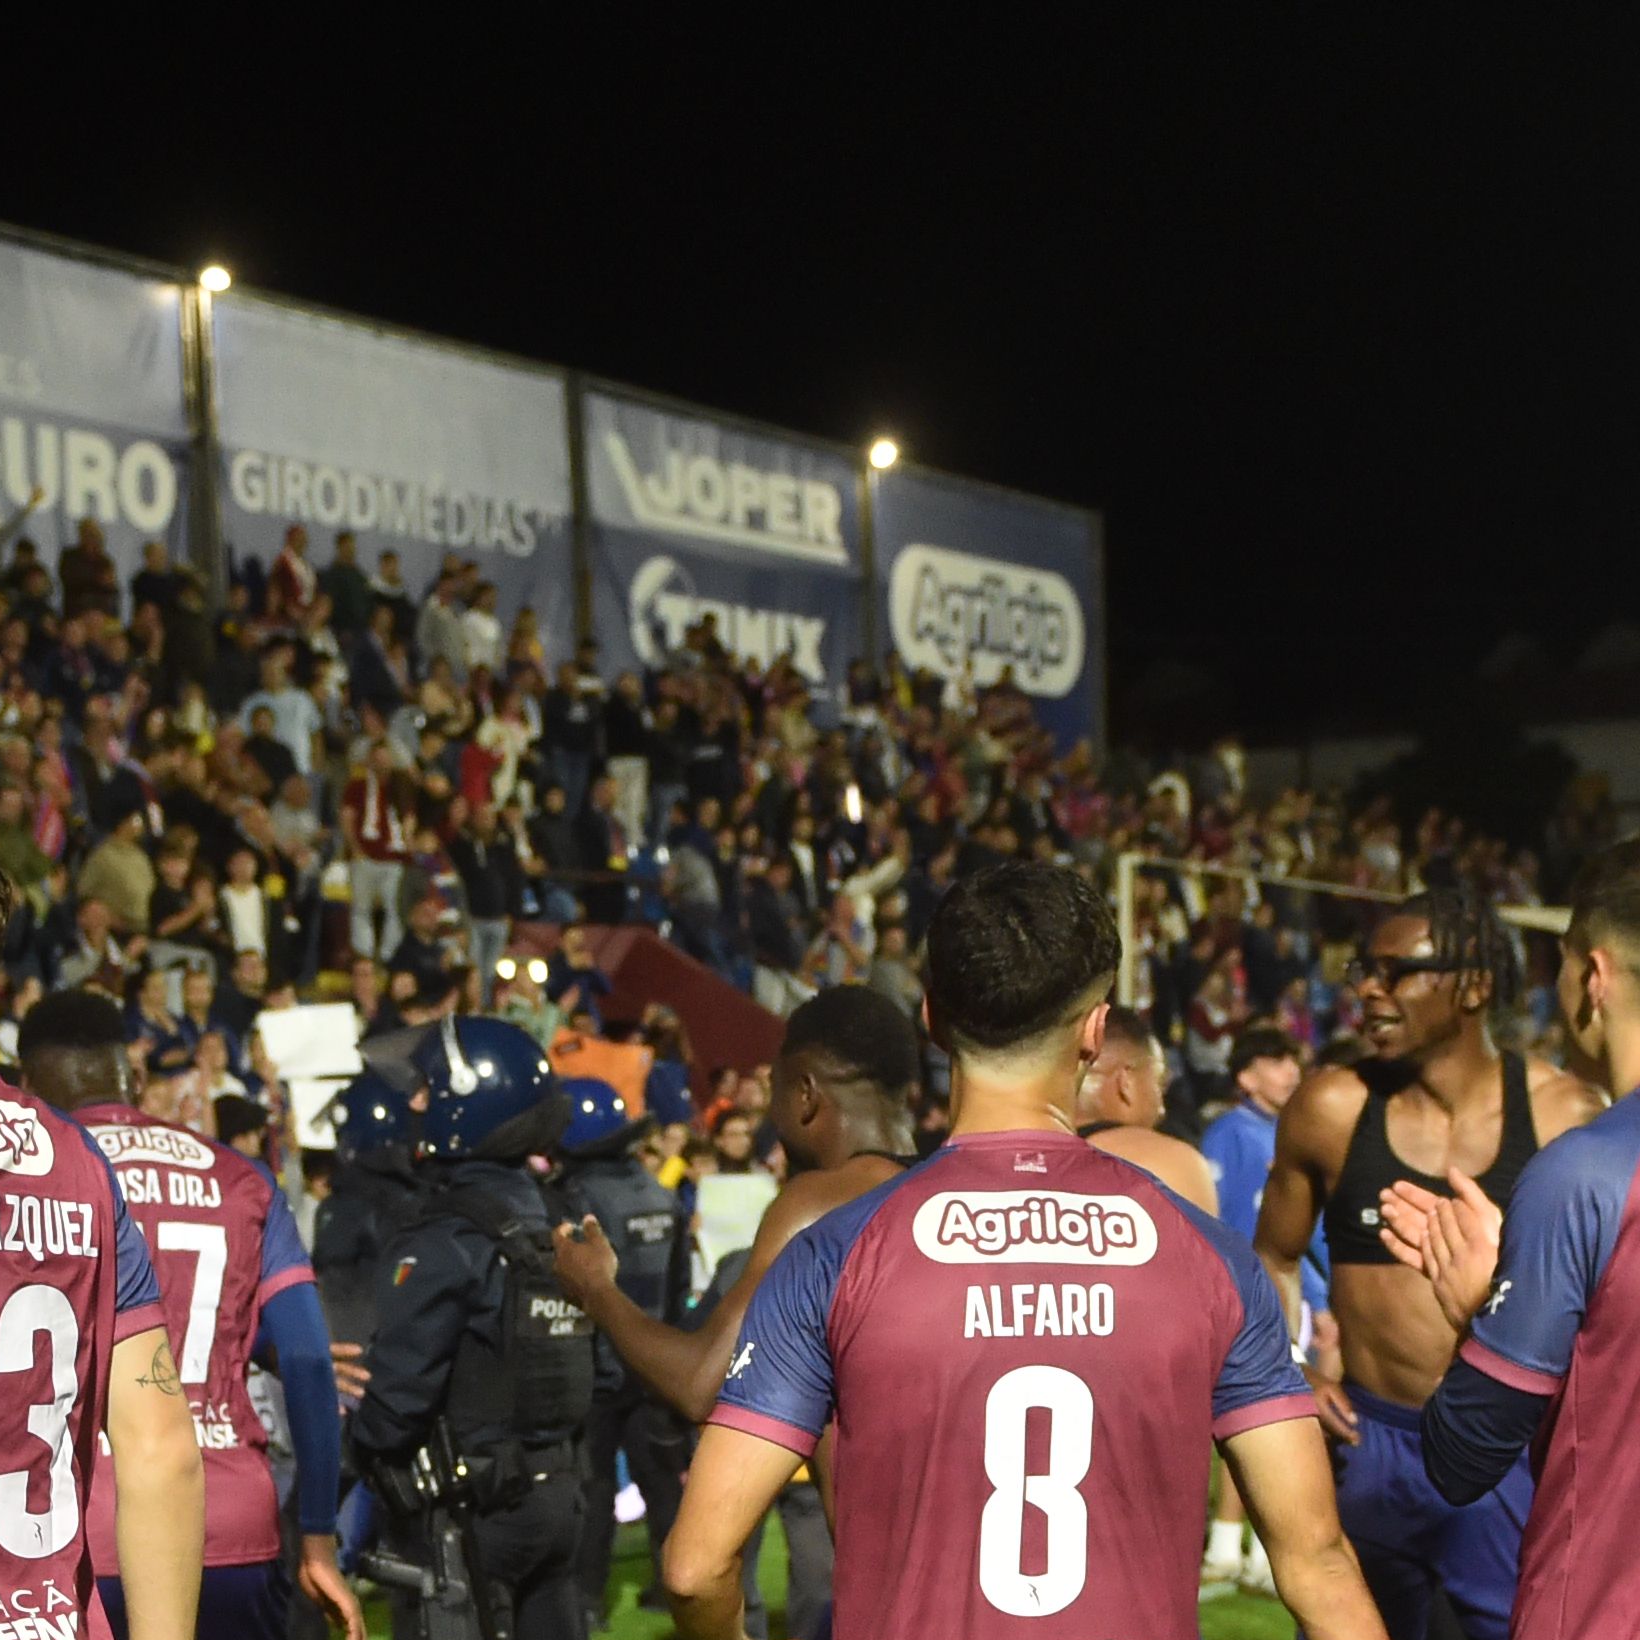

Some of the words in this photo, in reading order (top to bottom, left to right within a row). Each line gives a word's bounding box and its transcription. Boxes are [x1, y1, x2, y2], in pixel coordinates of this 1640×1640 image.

[645, 452, 841, 546] JOPER
[95, 1126, 203, 1161] griloja
[167, 1171, 222, 1209] DRJ
[937, 1197, 1137, 1257] Agriloja
[135, 1221, 228, 1384] 7
[964, 1283, 1115, 1338] ALFARO
[978, 1365, 1094, 1618] 8
